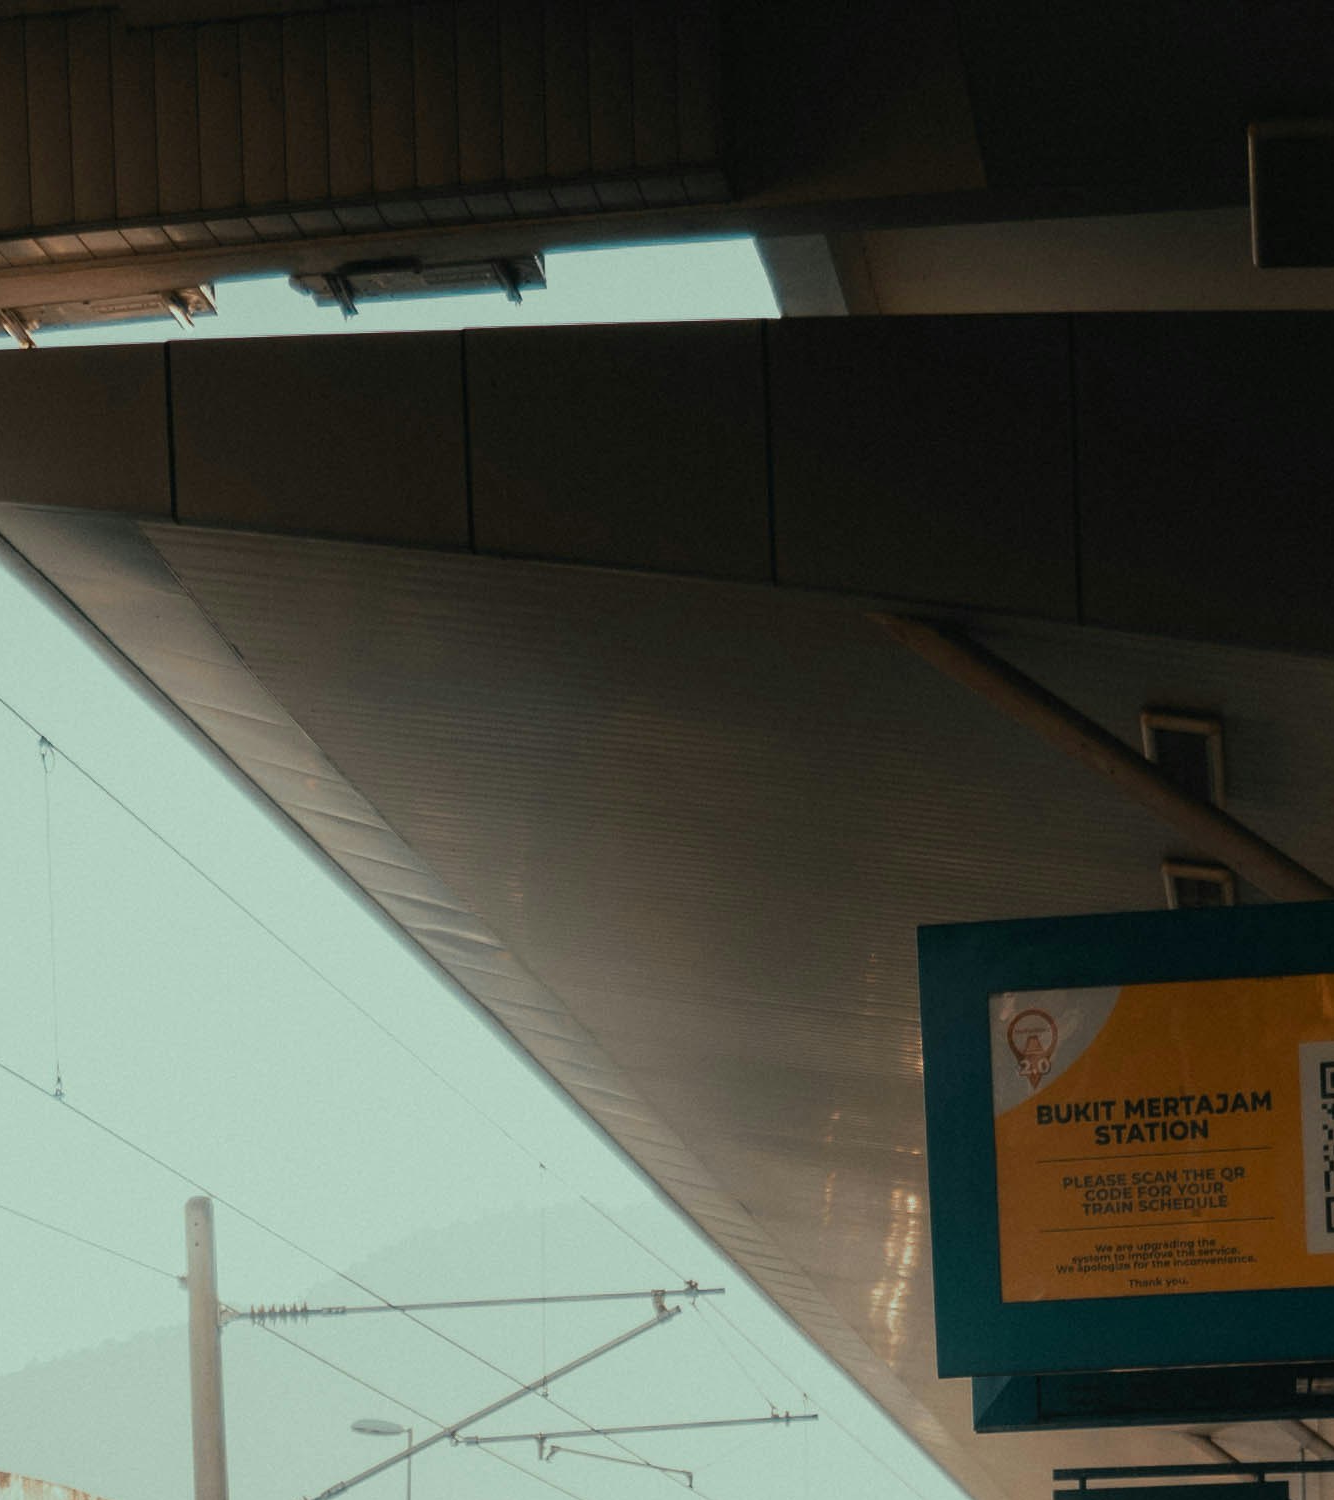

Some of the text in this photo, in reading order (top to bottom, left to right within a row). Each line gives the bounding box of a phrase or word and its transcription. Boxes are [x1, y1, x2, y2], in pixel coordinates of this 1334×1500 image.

[1017, 1058, 1052, 1076] 2.0
[1036, 1090, 1272, 1124] BUKIT MERTAJAM
[1094, 1119, 1209, 1145] STATION
[1062, 1166, 1245, 1189] PLEASE SCAN THE QR
[1084, 1182, 1224, 1201] CODE FOR YOUR
[1082, 1195, 1228, 1216] TRAIN SCHEDULE
[1072, 1246, 1241, 1265] system to improve the service.
[1095, 1238, 1216, 1254] We are upgrading the
[1056, 1264, 1074, 1273] We
[1133, 1260, 1148, 1270] for
[1151, 1258, 1170, 1268] the
[1174, 1254, 1257, 1267] inconvenience.
[1129, 1277, 1189, 1288] Thank you.
